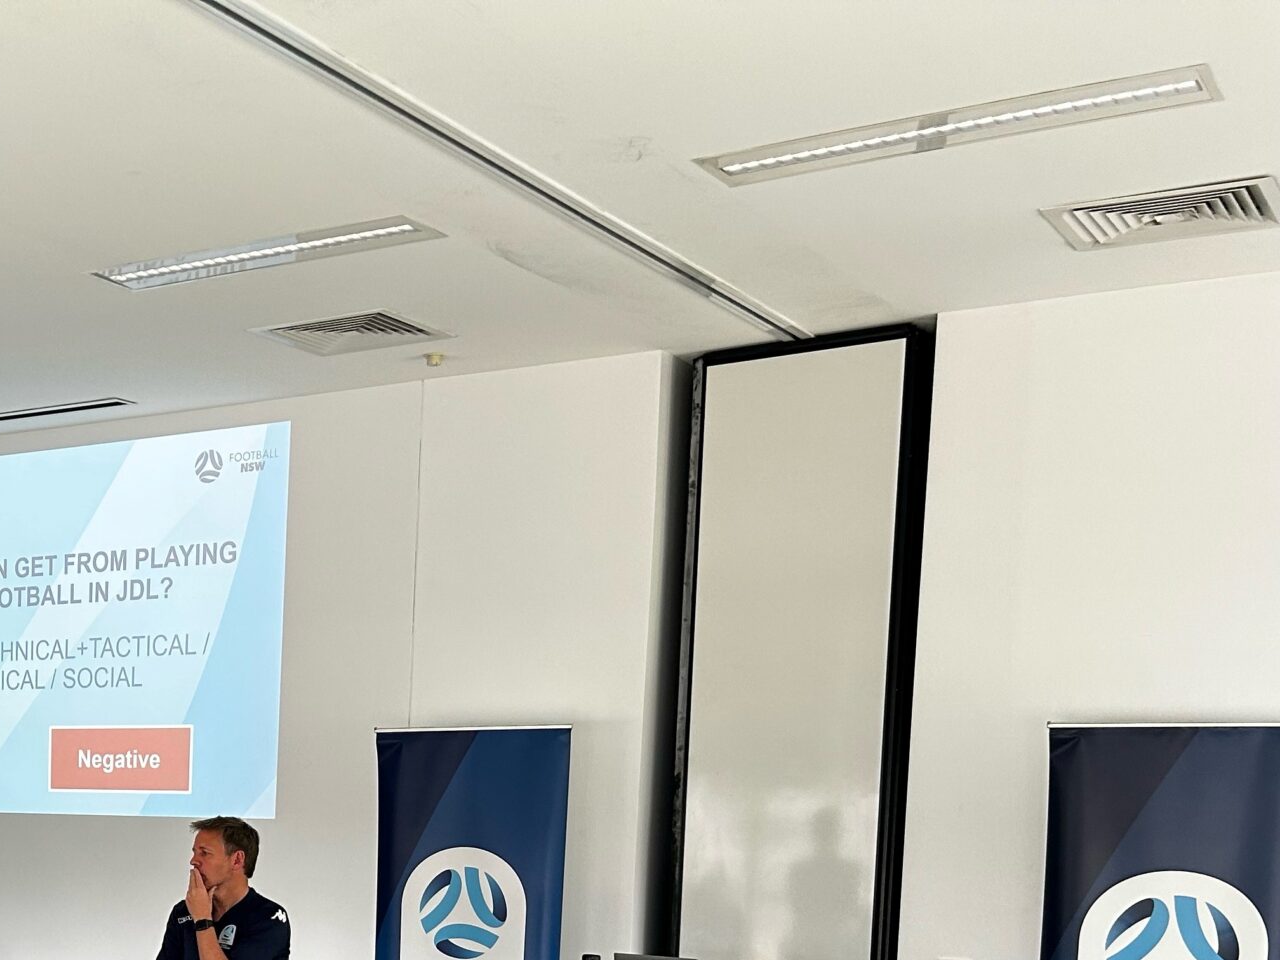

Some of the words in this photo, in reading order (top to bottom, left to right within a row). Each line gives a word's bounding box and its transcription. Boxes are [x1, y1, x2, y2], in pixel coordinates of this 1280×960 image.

[229, 448, 279, 462] FOOTBALL
[240, 460, 266, 473] NSW
[14, 554, 58, 578] GET
[64, 549, 128, 575] FROM
[135, 540, 238, 570] PLAYING
[88, 580, 110, 603] IN
[116, 576, 174, 602] JDL?
[202, 632, 211, 656] /
[50, 669, 58, 690] /
[63, 666, 143, 689] SOCIAL
[77, 748, 162, 772] Negative
